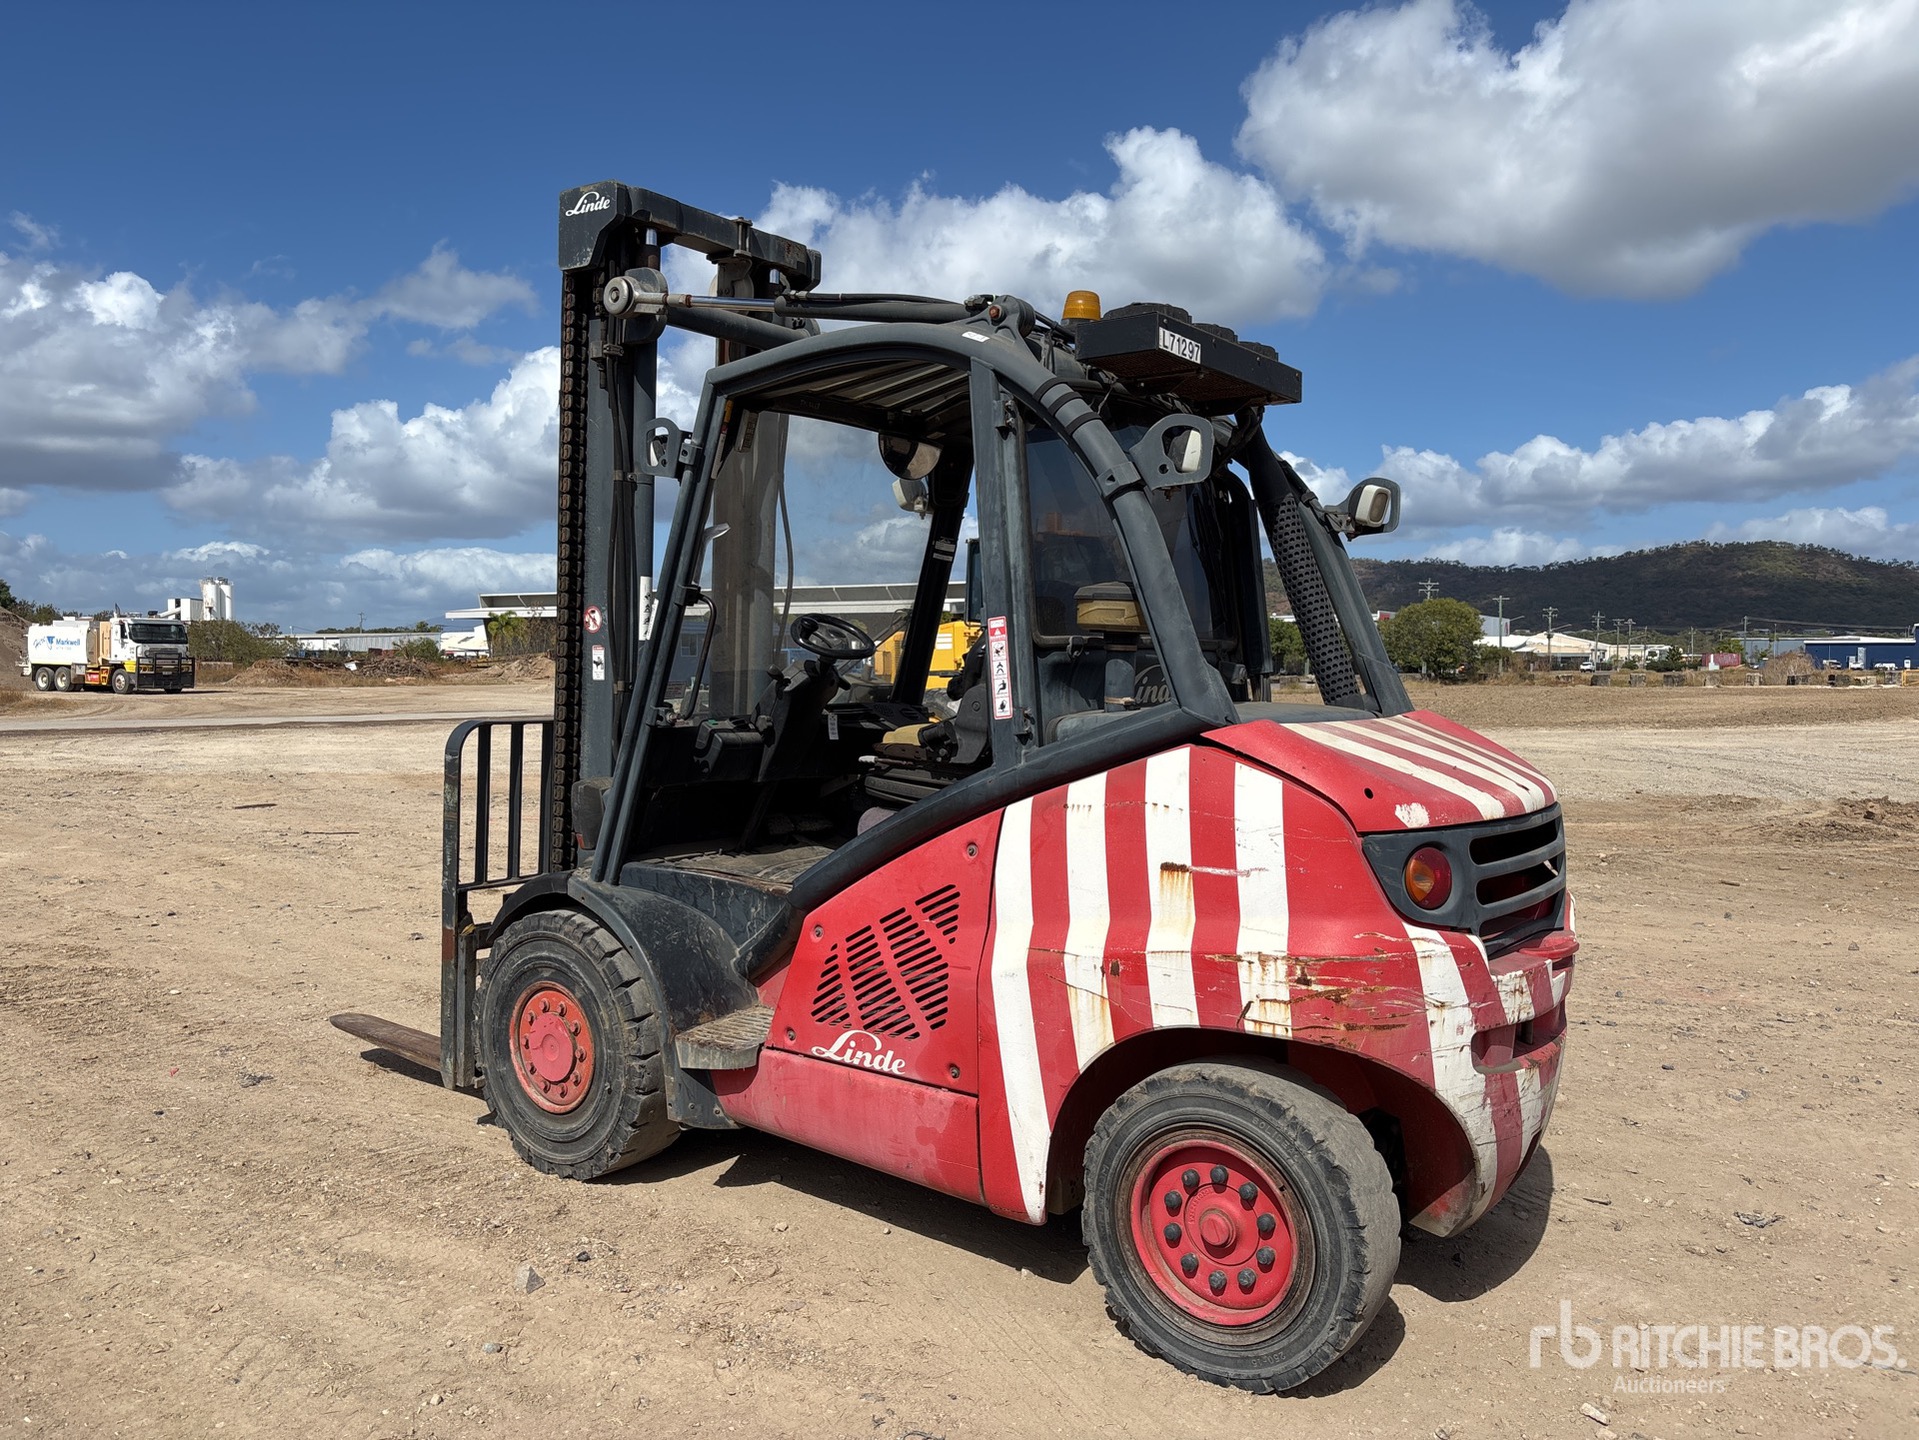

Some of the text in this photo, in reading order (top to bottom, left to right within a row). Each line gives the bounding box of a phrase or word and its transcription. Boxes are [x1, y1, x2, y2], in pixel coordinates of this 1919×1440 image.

[565, 191, 610, 217] Linde
[1162, 330, 1200, 362] L71297
[56, 638, 81, 646] Markwell
[1134, 664, 1172, 704] ind
[811, 1029, 906, 1075] Linde
